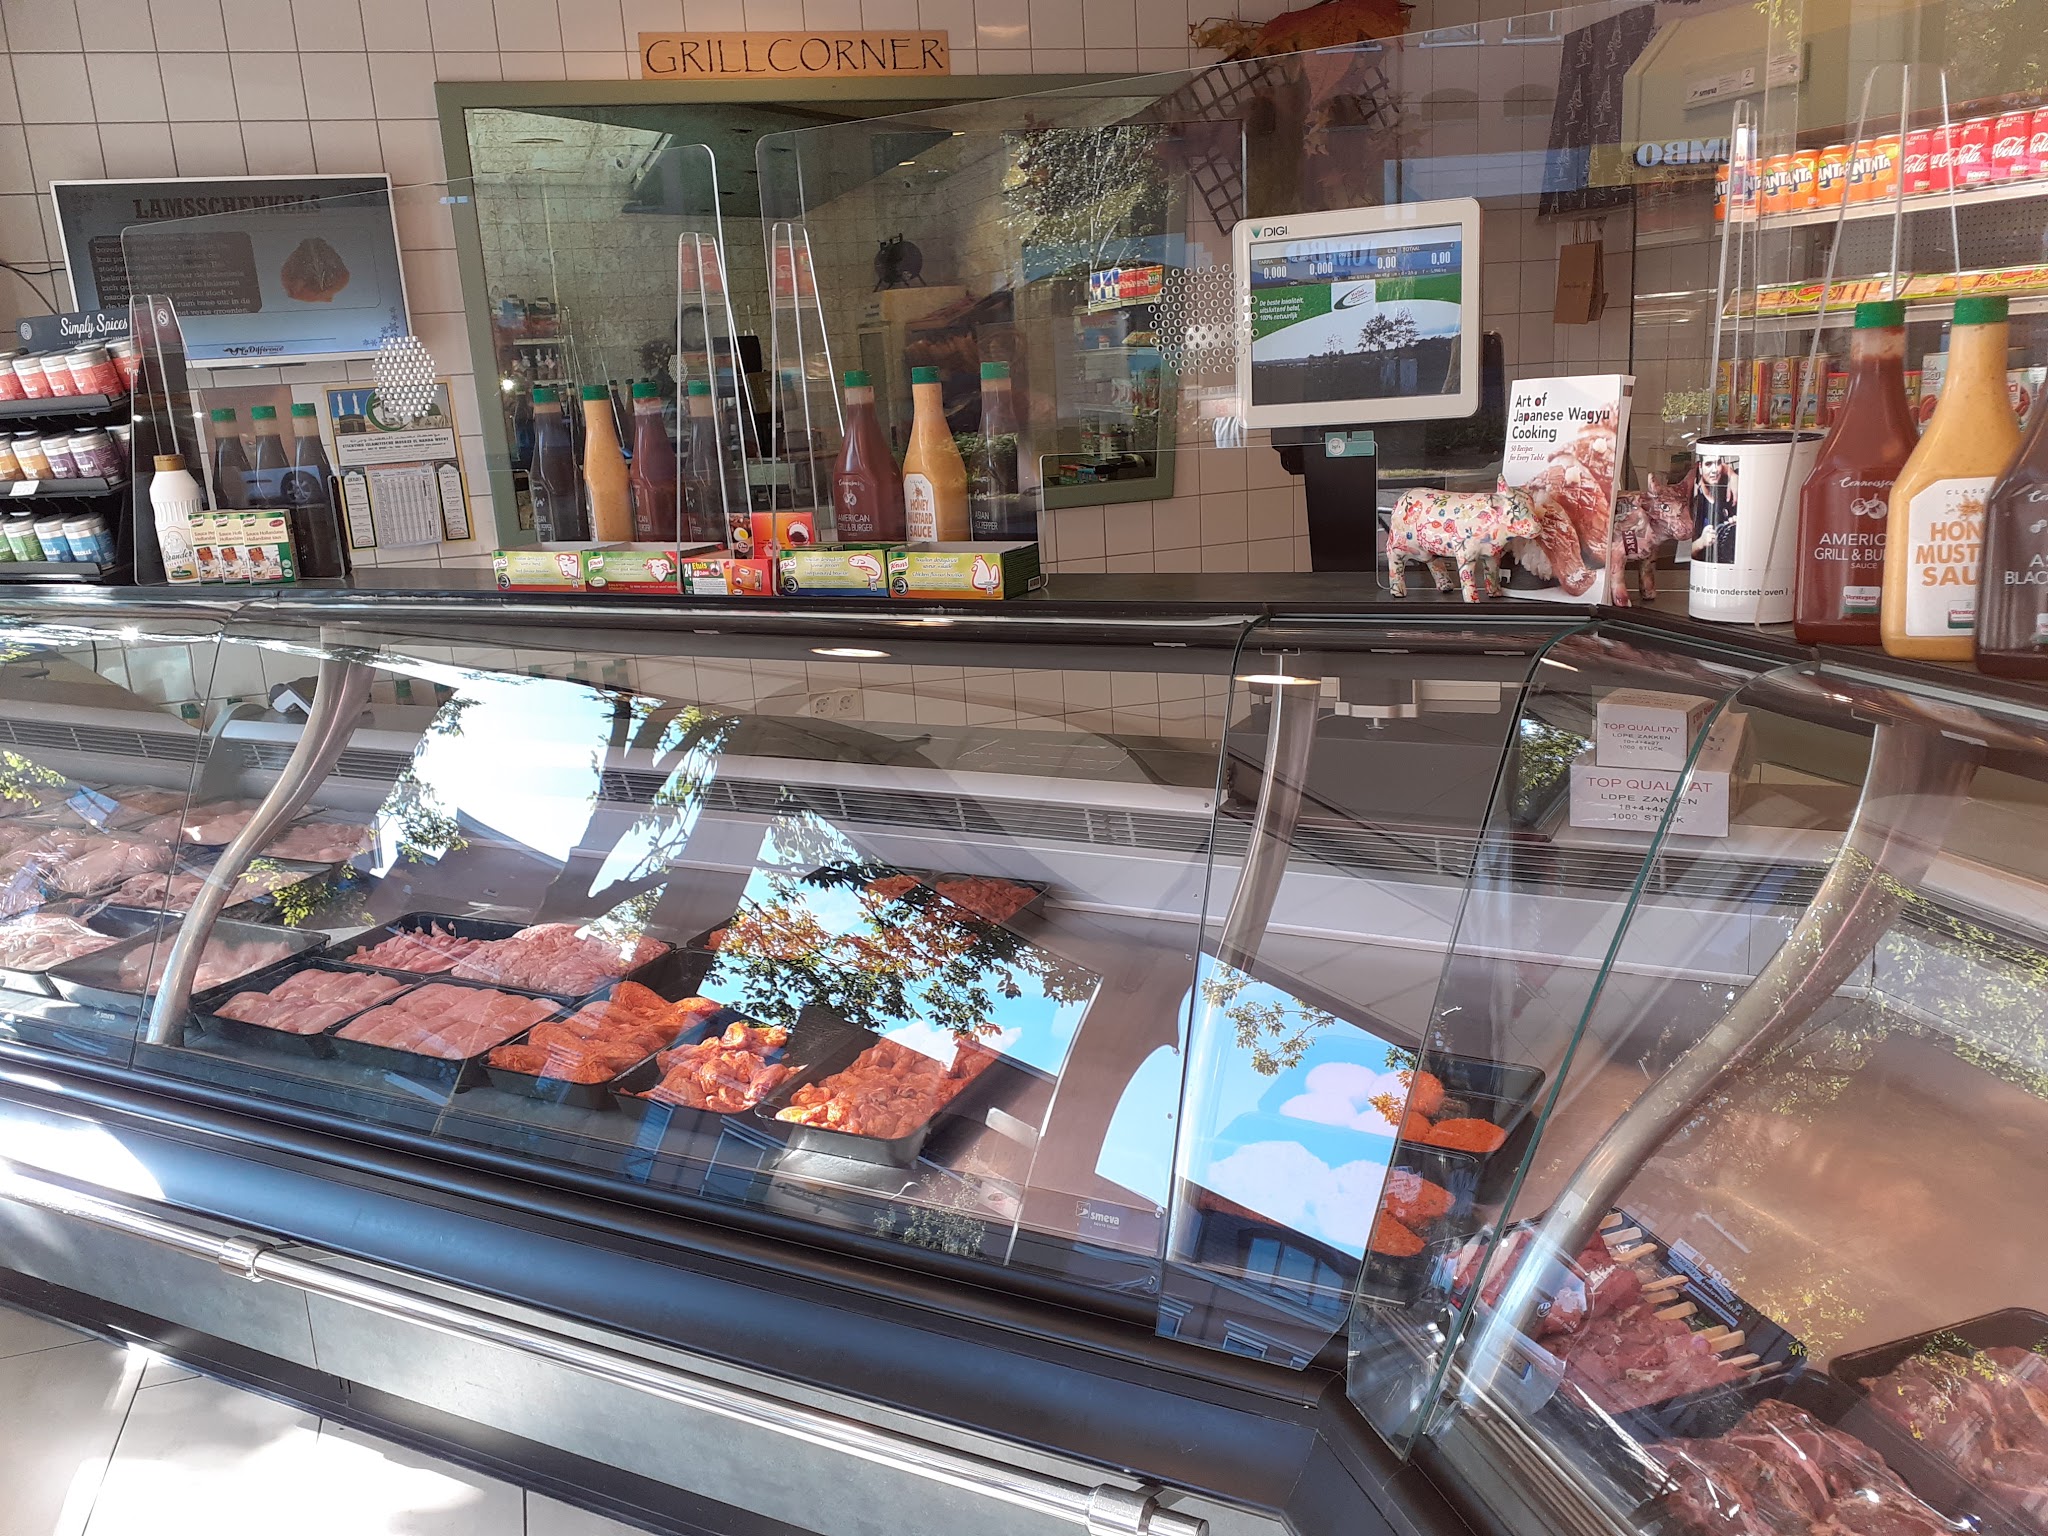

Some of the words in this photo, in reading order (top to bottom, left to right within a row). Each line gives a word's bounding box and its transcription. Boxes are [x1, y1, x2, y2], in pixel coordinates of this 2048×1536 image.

[646, 38, 945, 73] GRILLCORNER
[132, 194, 322, 219] LAMSSCHENKELS
[1264, 226, 1289, 237] DIGI
[1263, 266, 1287, 280] 0,000
[1309, 262, 1333, 276] 0,000
[1377, 256, 1397, 270] 0,00
[1431, 251, 1450, 265] 0,00
[60, 314, 95, 338] Simply
[97, 313, 128, 339] Spices
[1515, 394, 1531, 408] Art
[1535, 392, 1548, 407] of
[1513, 409, 1563, 425] Japanese
[1568, 407, 1610, 424] Wagyu
[1512, 426, 1558, 442] Cooking
[1517, 445, 1533, 453] Recipes
[1508, 454, 1517, 462] for
[1517, 454, 1530, 463] Every
[910, 498, 929, 511] HONEY
[838, 513, 870, 522] AMERICAN
[908, 513, 933, 524] MUSTARD
[910, 525, 932, 537] SAUCE
[1624, 530, 1637, 555] PARIS
[1814, 547, 1848, 561] GRILL
[1851, 547, 1862, 561] &
[1864, 548, 1885, 561] BU
[1701, 586, 1718, 595] leven
[1604, 722, 1626, 730] TOP
[1627, 724, 1680, 734] QUALITAT
[1586, 777, 1622, 788] TOP
[1626, 779, 1713, 793] QUALAT
[1601, 793, 1636, 802] LDPE
[1642, 795, 1698, 805] ZAKEN
[1090, 1211, 1120, 1225] smeva
